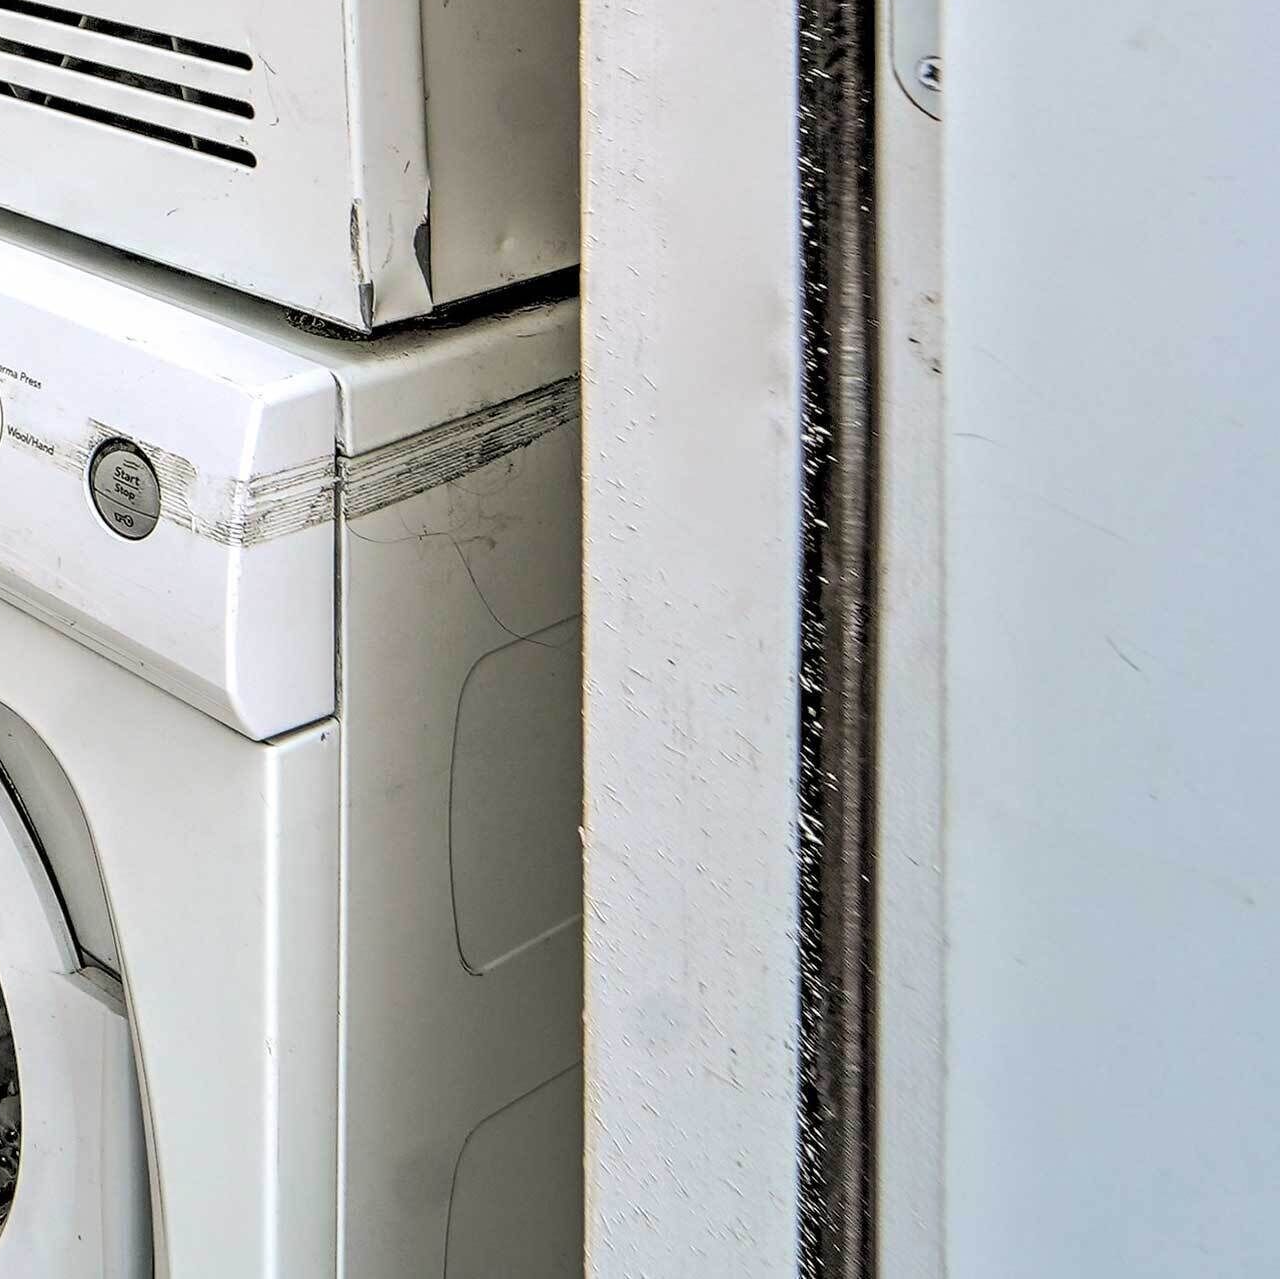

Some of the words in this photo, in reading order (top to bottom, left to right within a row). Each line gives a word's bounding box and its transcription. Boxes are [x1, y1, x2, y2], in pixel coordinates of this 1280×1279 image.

[19, 371, 42, 390] Press
[7, 424, 55, 456] Wool/Hand
[114, 466, 141, 486] Start
[114, 483, 136, 502] Stop
